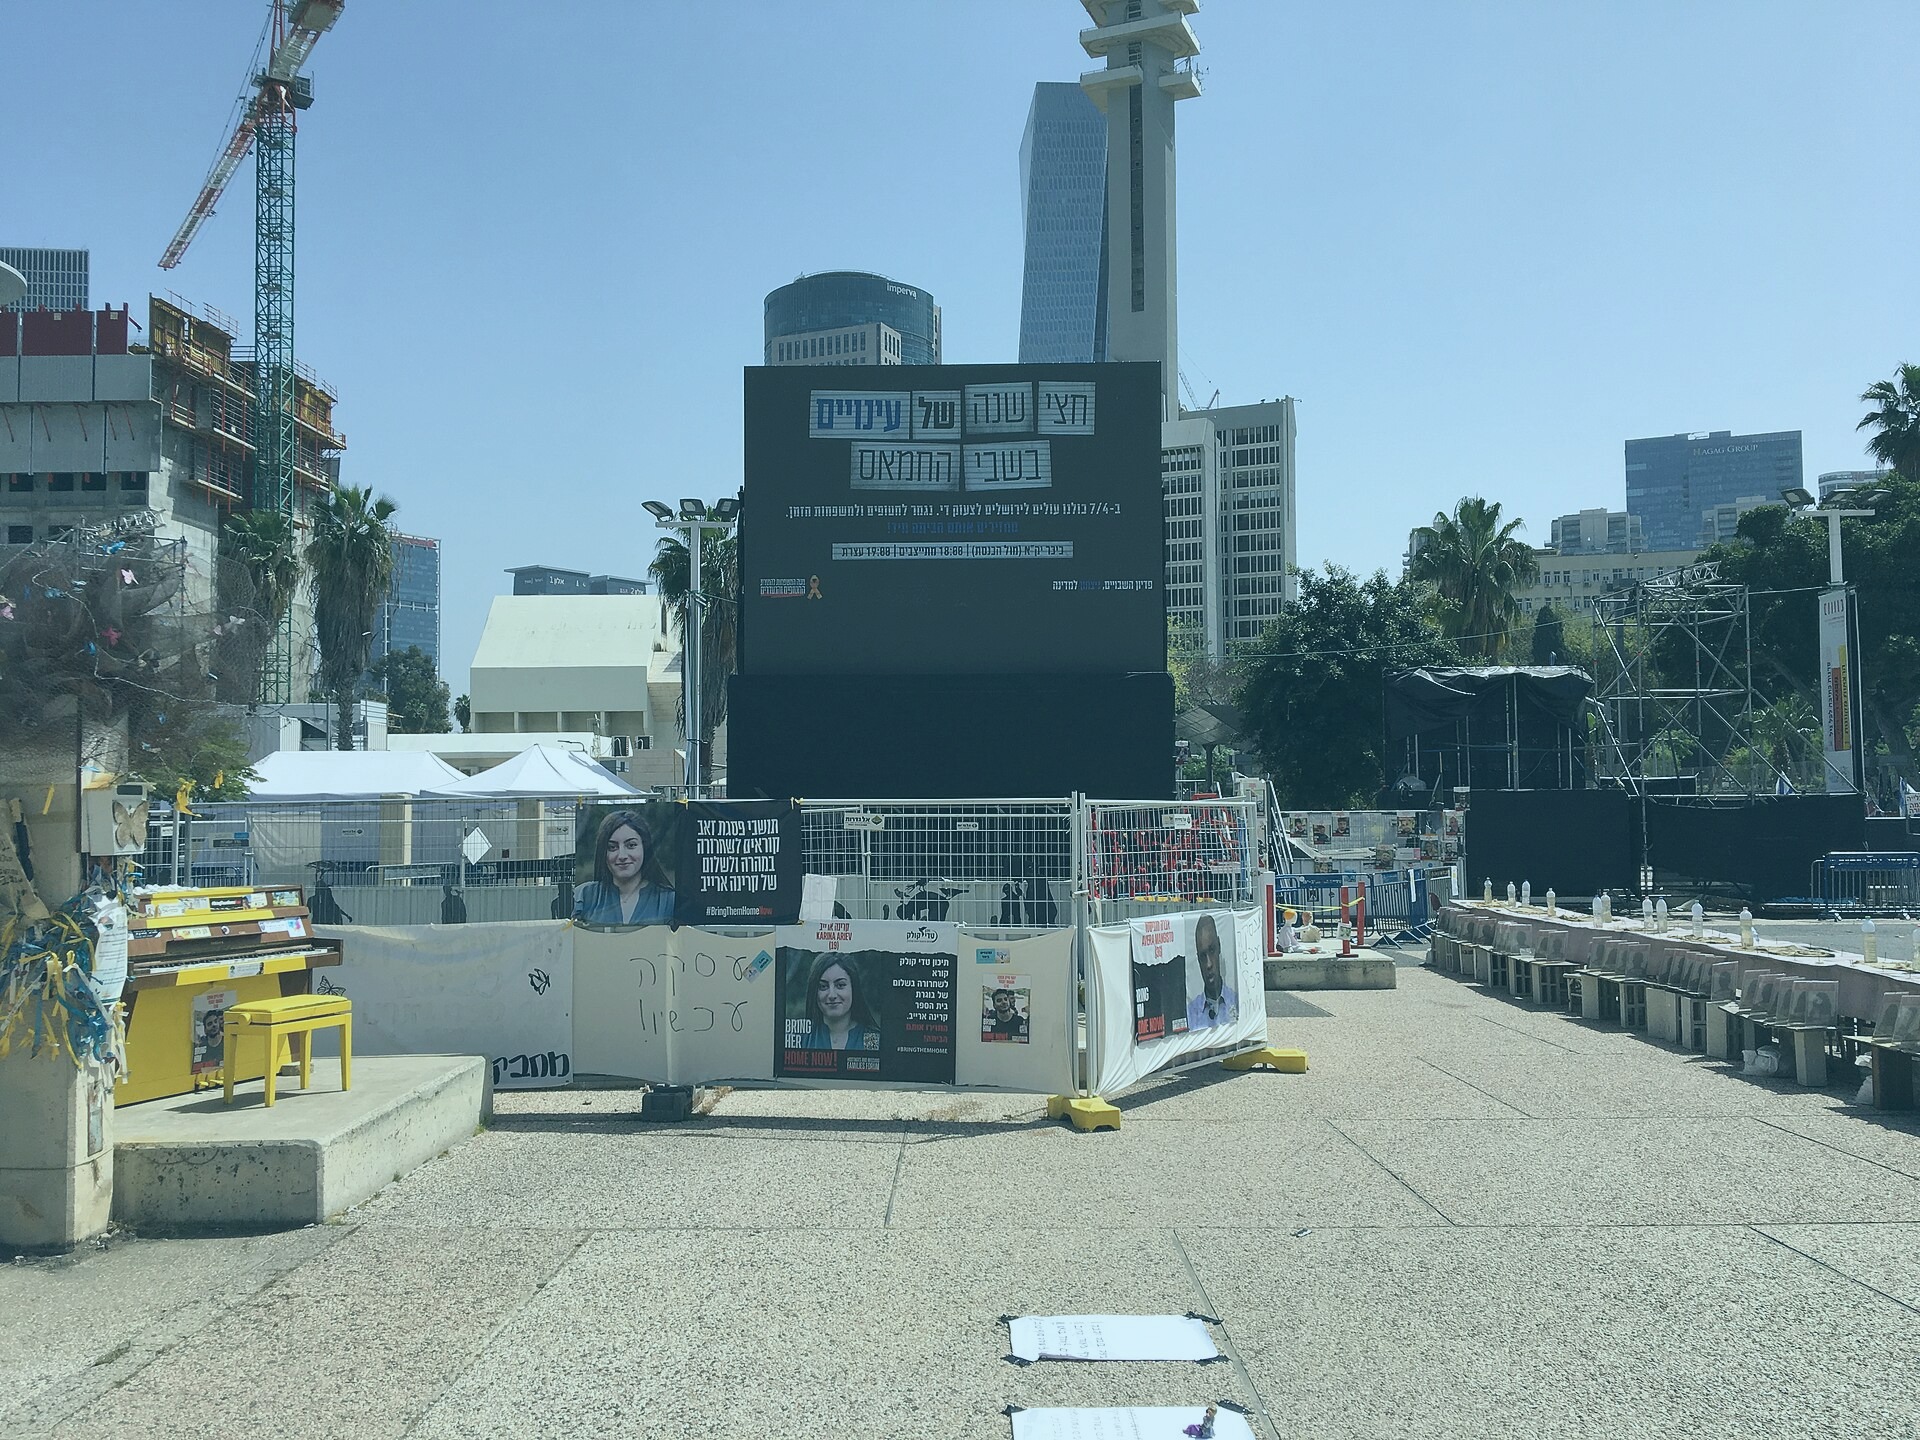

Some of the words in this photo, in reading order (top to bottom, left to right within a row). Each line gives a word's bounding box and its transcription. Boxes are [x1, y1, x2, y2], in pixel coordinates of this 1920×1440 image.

[918, 396, 955, 429] של
[973, 391, 1025, 424] שנה
[1045, 392, 1088, 426] חצי
[816, 398, 901, 433] עינויים
[858, 449, 952, 483] החמאס
[974, 449, 1042, 483] בשבי
[814, 503, 864, 517] ולמשפחות
[867, 503, 908, 517] לחטופים
[910, 504, 933, 516] נגמר
[952, 502, 982, 517] לצעוק
[985, 502, 1030, 516] לירושלים
[1032, 502, 1060, 516] עולים
[1062, 502, 1087, 515] כולנו
[1052, 579, 1078, 590] למדינה
[1135, 580, 1153, 591] פדיון
[697, 820, 716, 836] זאב
[717, 820, 746, 836] פסגת
[747, 819, 779, 836] תושבי
[697, 838, 742, 854] לשחרורה
[743, 837, 780, 855] קוראים
[702, 856, 739, 873] ולשלום
[740, 855, 776, 873] במהרה
[700, 875, 728, 892] ארייב
[729, 875, 759, 893] קרינה
[760, 873, 777, 891] של
[899, 957, 917, 967] קולק
[918, 958, 931, 966] טדי
[932, 958, 949, 968] תיכון
[629, 952, 747, 996] עסקה
[931, 969, 949, 979] קורא
[892, 979, 916, 987] בשלום
[917, 980, 949, 989] לשחרורה
[915, 991, 935, 999] בוגרת
[937, 991, 949, 999] של
[915, 1001, 934, 1010] הספר
[935, 1002, 949, 1010] בית
[928, 1013, 948, 1022] קרינה
[785, 1018, 812, 1034] BRING
[784, 1033, 802, 1049] HER
[784, 1050, 809, 1066] HOME
[811, 1050, 838, 1067] NOW!
